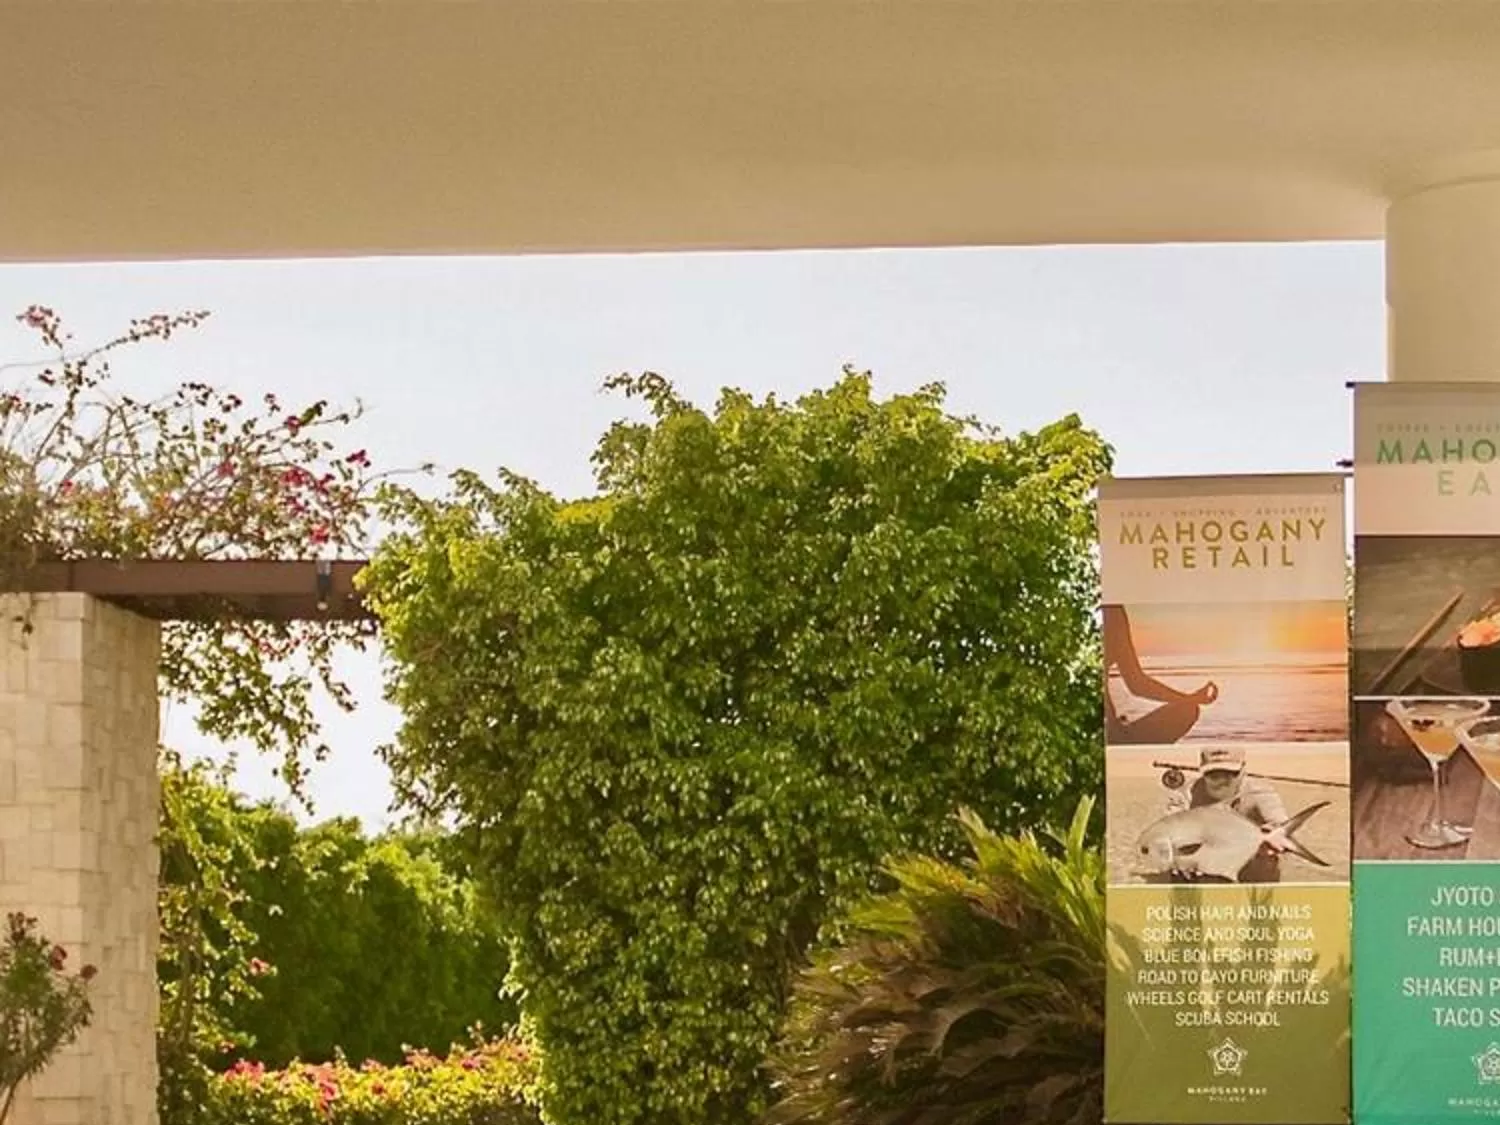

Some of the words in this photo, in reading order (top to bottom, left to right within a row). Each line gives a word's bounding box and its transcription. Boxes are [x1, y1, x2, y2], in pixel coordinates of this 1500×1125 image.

[1119, 518, 1326, 545] MAHOGANY
[1153, 546, 1295, 569] RETAIL
[1431, 886, 1494, 907] JYOTO
[1146, 904, 1197, 921] POLISH
[1200, 904, 1235, 921] HAIR
[1238, 904, 1267, 921] AND
[1269, 904, 1312, 921] NAILS
[1142, 927, 1201, 943] SCIENCE
[1204, 927, 1234, 942] AND
[1236, 927, 1275, 942] SOUL
[1277, 926, 1314, 941] YOGA
[1407, 916, 1462, 937] FARM
[1144, 948, 1179, 964] BLUE
[1256, 948, 1312, 963] FISHING
[1138, 969, 1176, 985] ROAD
[1180, 969, 1198, 985] TO
[1201, 969, 1238, 985] CAYO
[1241, 969, 1319, 985] FURNITURE
[1402, 977, 1483, 997] SHAKEN
[1128, 991, 1186, 1005] WHEELS
[1188, 991, 1224, 1005] GOLF
[1227, 991, 1264, 1005] CART
[1267, 991, 1329, 1005] RENTALS
[1176, 1012, 1222, 1027] SCUBA
[1224, 1012, 1281, 1027] SCHOOL
[1432, 1007, 1483, 1028] TACO
